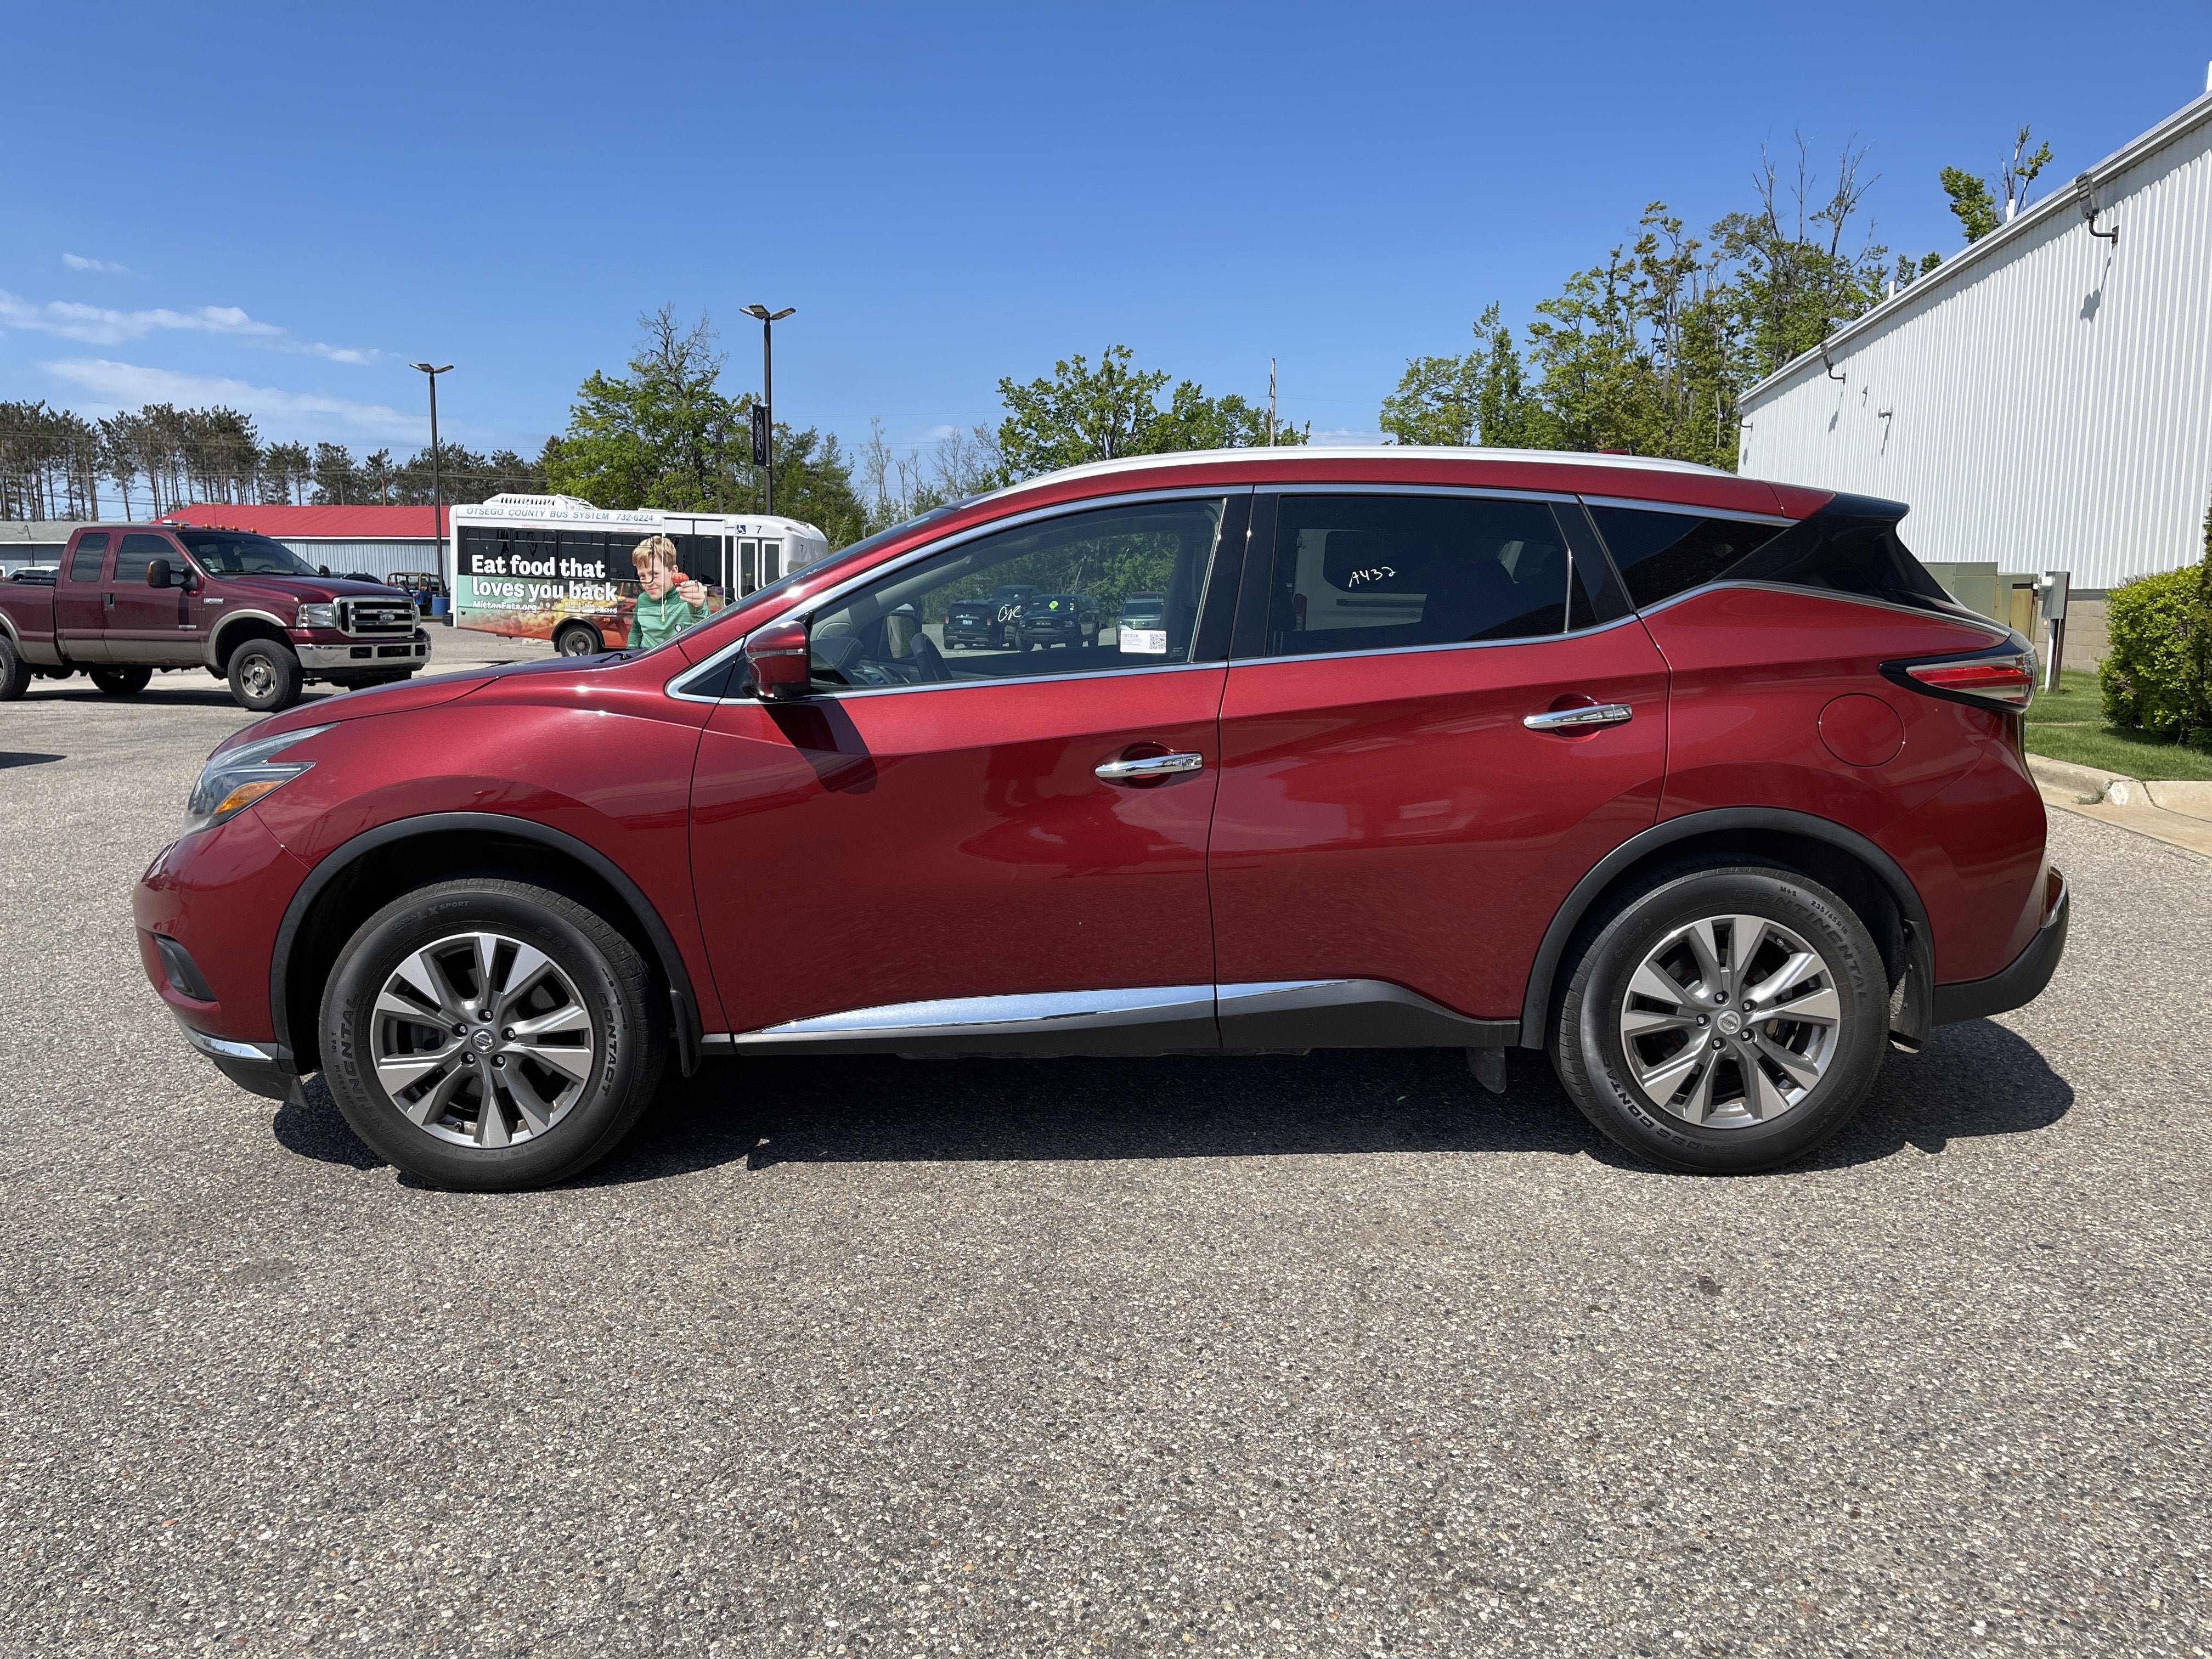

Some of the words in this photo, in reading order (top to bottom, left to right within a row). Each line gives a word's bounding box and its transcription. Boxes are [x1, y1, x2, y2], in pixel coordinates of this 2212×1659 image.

[466, 507, 504, 516] OTSEGO
[508, 509, 545, 517] COUNTY
[573, 511, 610, 520] SYSTEM
[616, 514, 654, 522] 732-6224
[756, 526, 762, 534] 7
[800, 544, 804, 553] 7
[472, 555, 506, 574] Eat
[510, 555, 555, 576] food
[559, 557, 606, 578] that
[472, 576, 524, 597] loves
[528, 583, 564, 603] you
[569, 580, 618, 601] back
[472, 600, 537, 613] MittenEats.org
[1780, 886, 1797, 897] M+S
[439, 901, 470, 910] SPORT
[1734, 889, 1869, 1008] CONTINENTAL
[597, 992, 617, 1097] CONTACT
